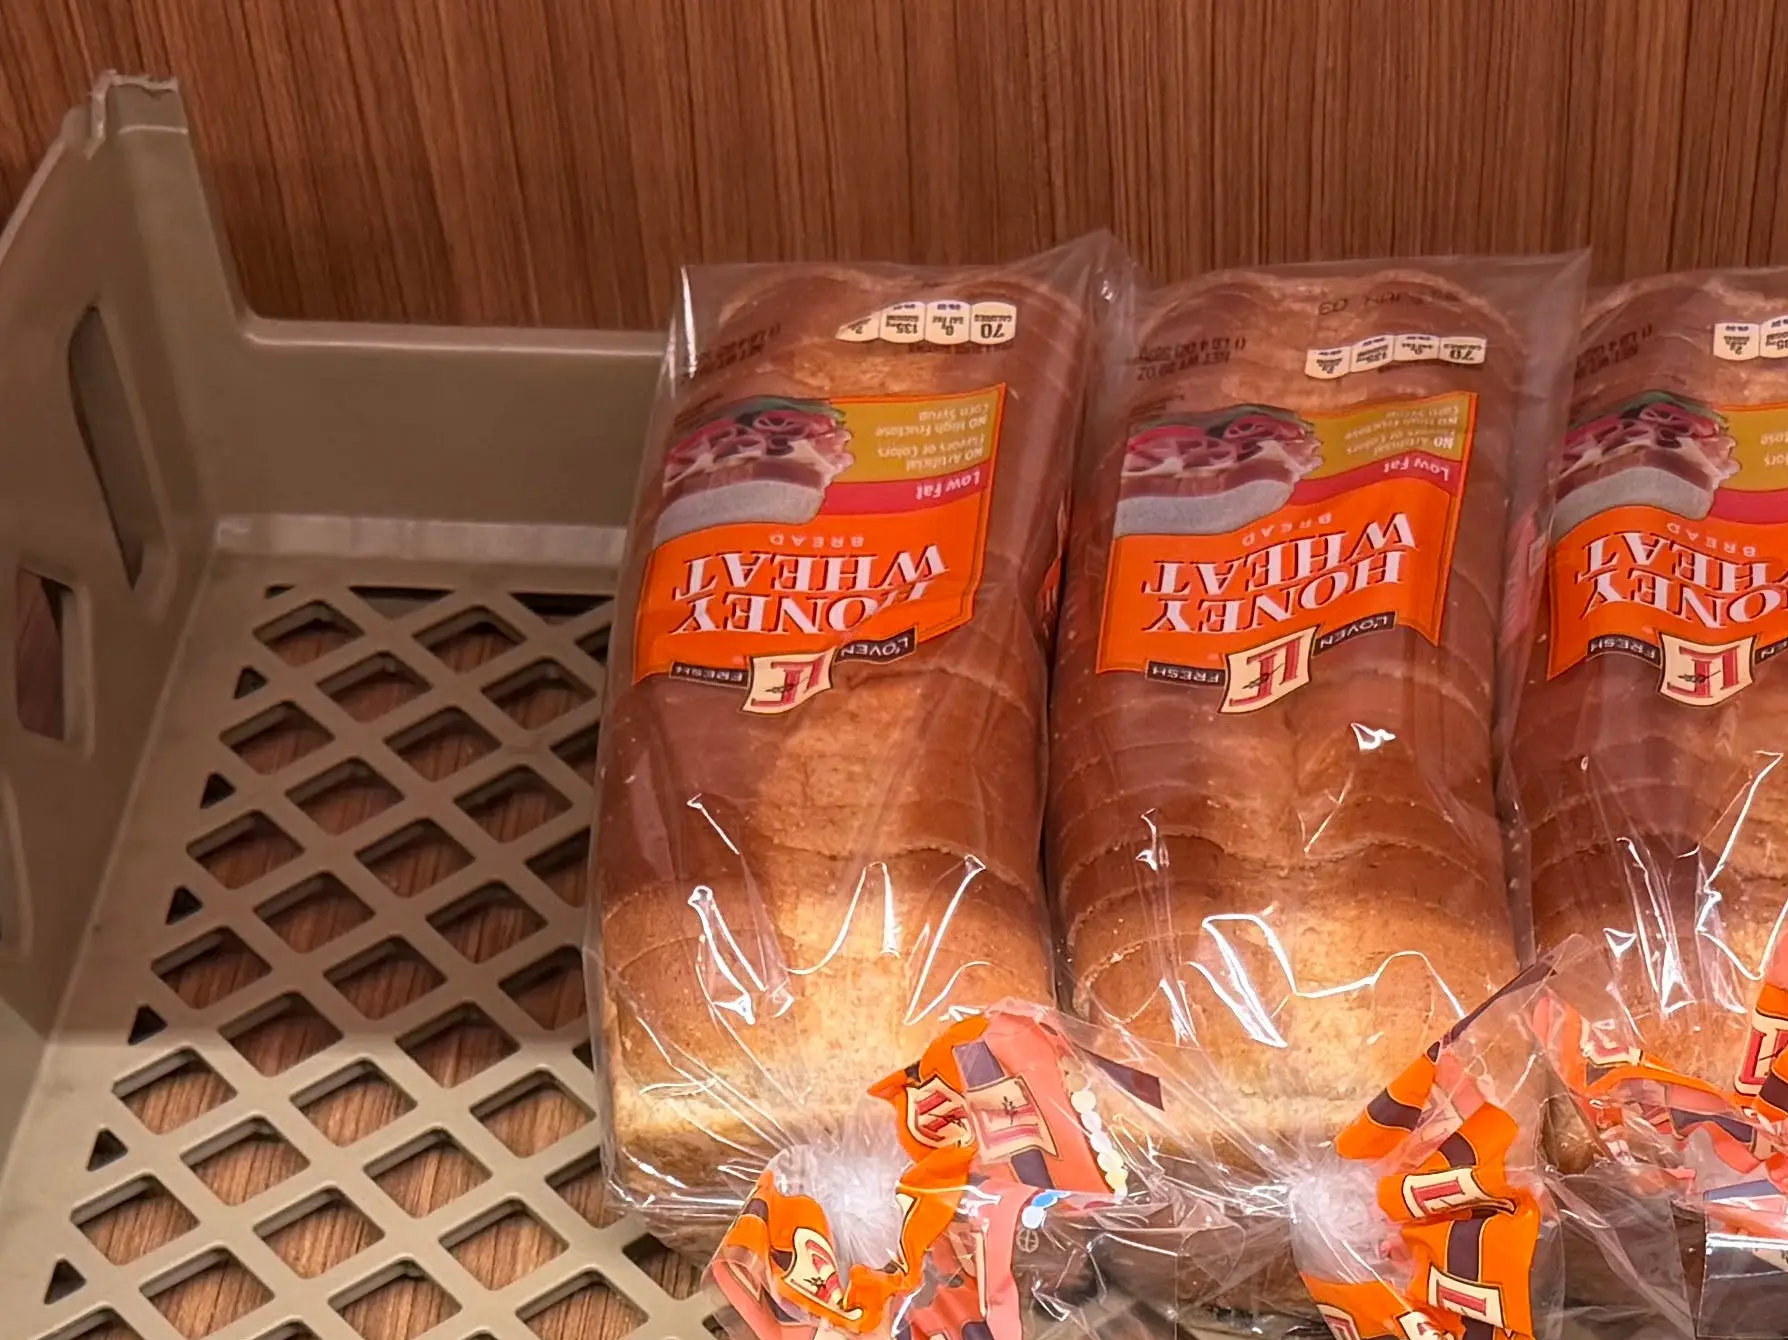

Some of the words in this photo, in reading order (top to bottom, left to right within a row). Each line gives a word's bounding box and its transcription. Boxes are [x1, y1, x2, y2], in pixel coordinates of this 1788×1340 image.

[981, 324, 1005, 338] 70
[1433, 437, 1454, 448] NO
[1383, 457, 1409, 472] Fat
[1414, 458, 1449, 481] Low
[946, 471, 980, 491] Low
[916, 484, 942, 500] Fat
[1241, 513, 1331, 546] BREAD
[1665, 522, 1756, 557] BREAD
[769, 533, 864, 547] BREAD
[1141, 513, 1418, 595] WHEAT
[671, 544, 948, 600] WHEAT
[1141, 550, 1405, 634] HONEY
[1319, 615, 1388, 648] L'OVEN
[1590, 637, 1656, 658] FRESH
[674, 665, 743, 681] FRESH
[1152, 665, 1220, 684] FRESH
